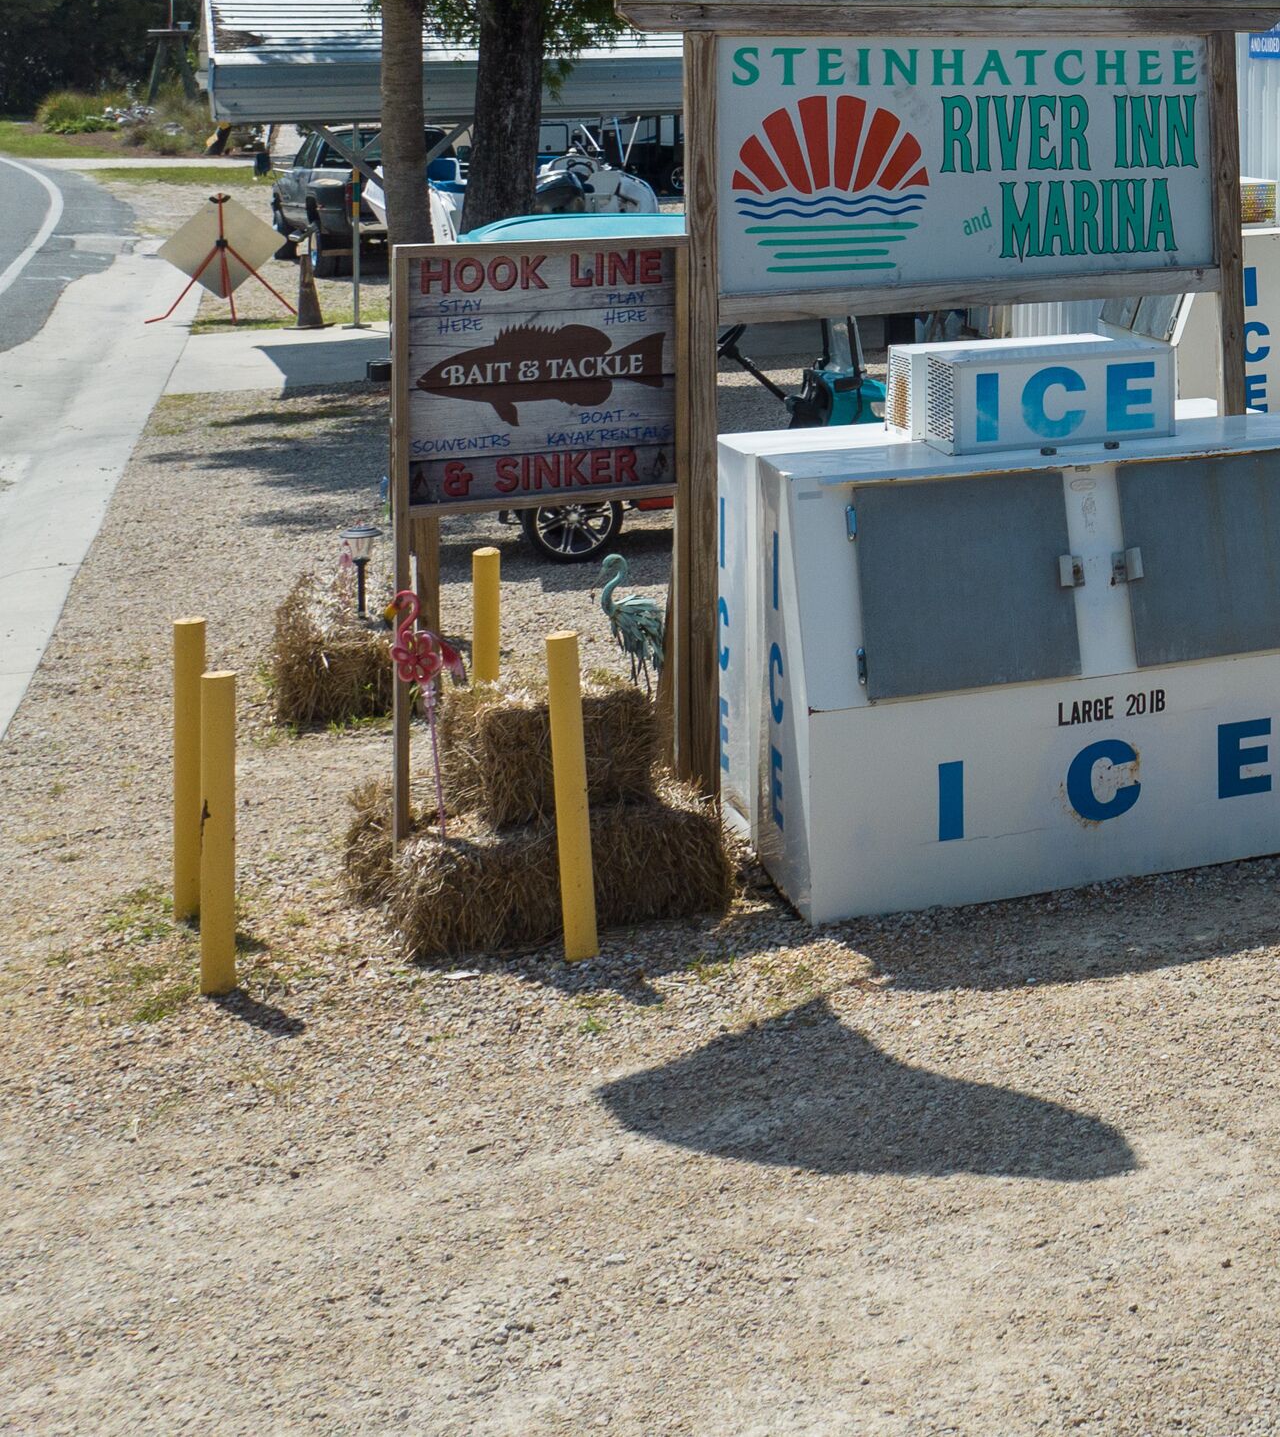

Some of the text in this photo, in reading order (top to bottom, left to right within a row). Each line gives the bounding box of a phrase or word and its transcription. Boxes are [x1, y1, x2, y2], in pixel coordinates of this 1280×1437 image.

[1250, 38, 1261, 52] AND
[732, 47, 1198, 86] STEINHATCHEE
[940, 94, 1199, 174] RIVER INN
[963, 178, 1178, 263] and MARINA
[420, 249, 663, 295] HOOK LINE
[438, 298, 482, 313] STAY
[607, 291, 646, 306] PLAY
[437, 318, 484, 335] HERE
[603, 310, 648, 325] HERE
[440, 353, 644, 387] BAIT & TACKLE
[578, 409, 625, 425] BOAT
[975, 361, 1156, 442] ICE
[411, 433, 511, 454] SOUVENIRS
[546, 432, 595, 447] KAYAK
[443, 449, 641, 498] & SINKER
[769, 531, 784, 832] ICE
[1058, 696, 1114, 727] LARGE
[937, 716, 1272, 842] ICE
